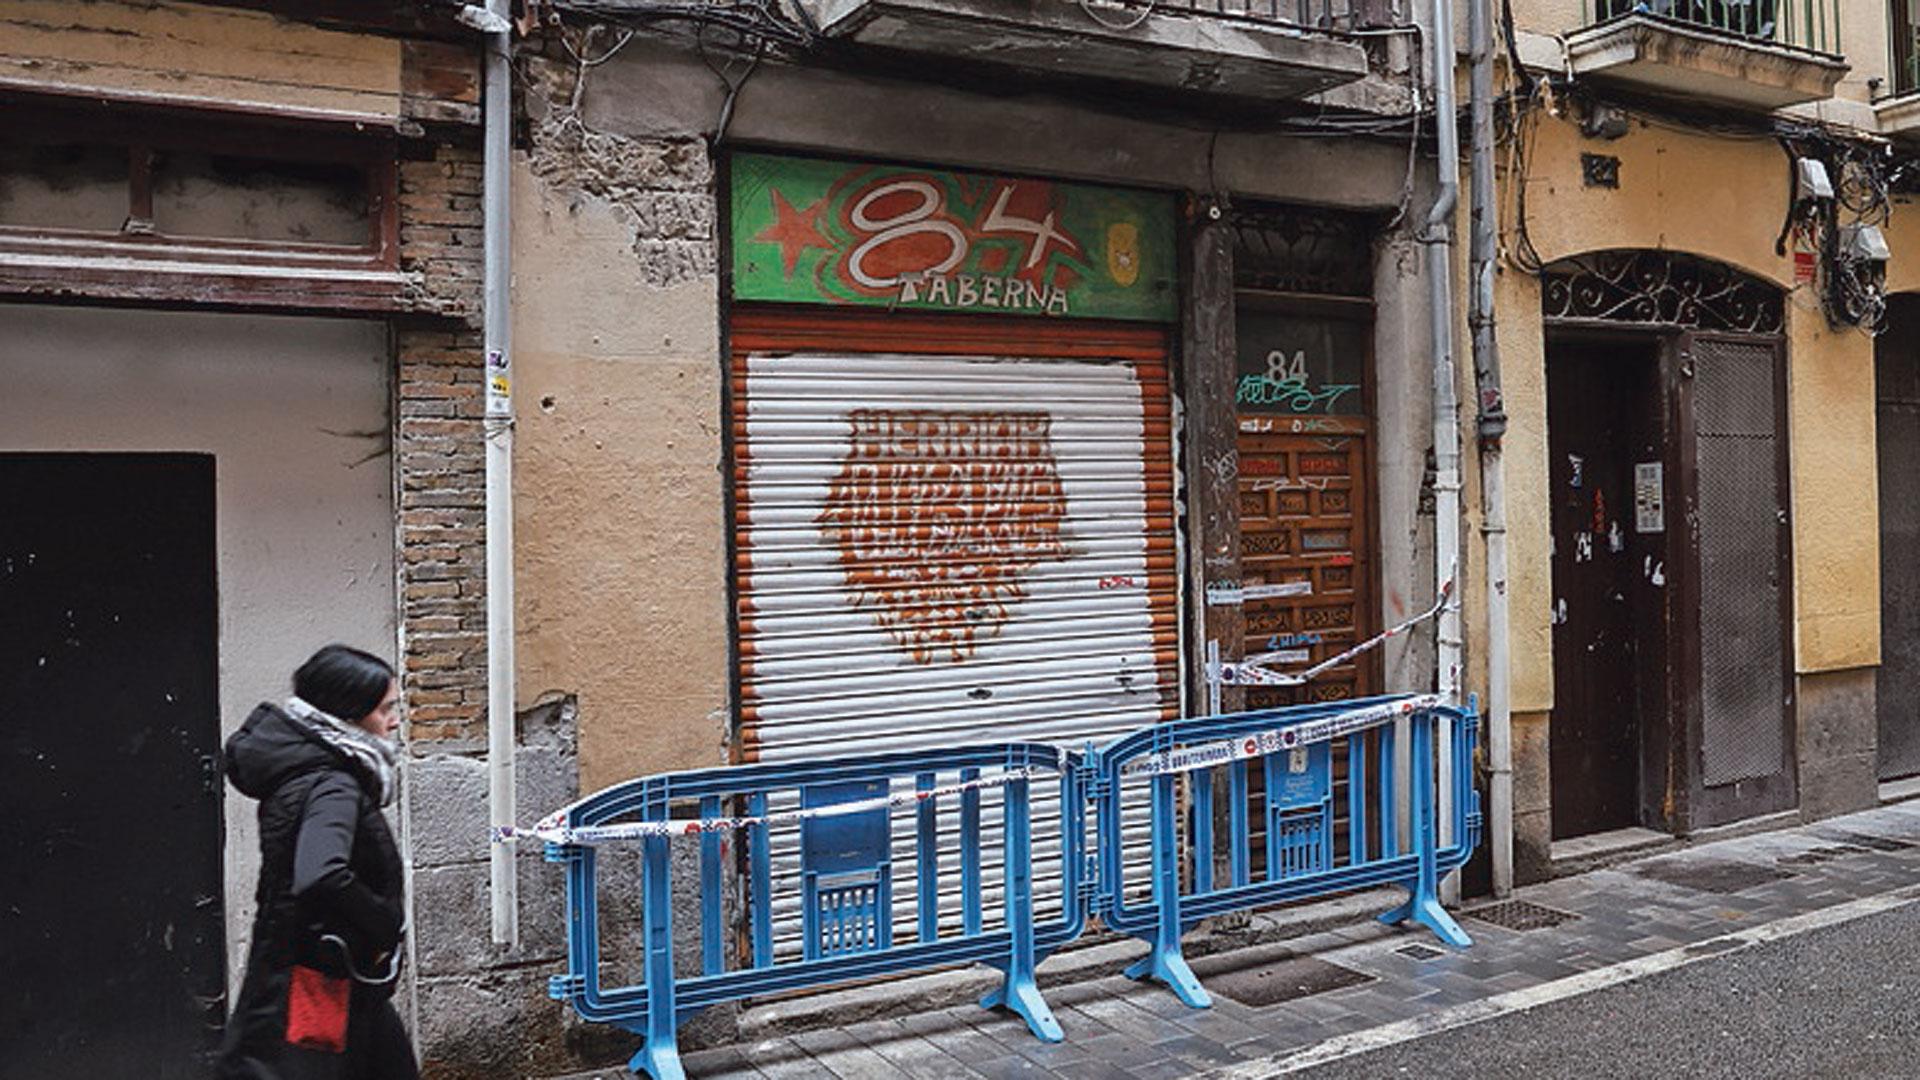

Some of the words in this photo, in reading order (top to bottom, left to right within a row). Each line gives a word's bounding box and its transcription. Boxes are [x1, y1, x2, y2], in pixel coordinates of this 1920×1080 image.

[849, 180, 1077, 288] 84
[896, 272, 1070, 315] TABERNA
[1267, 351, 1309, 386] 84
